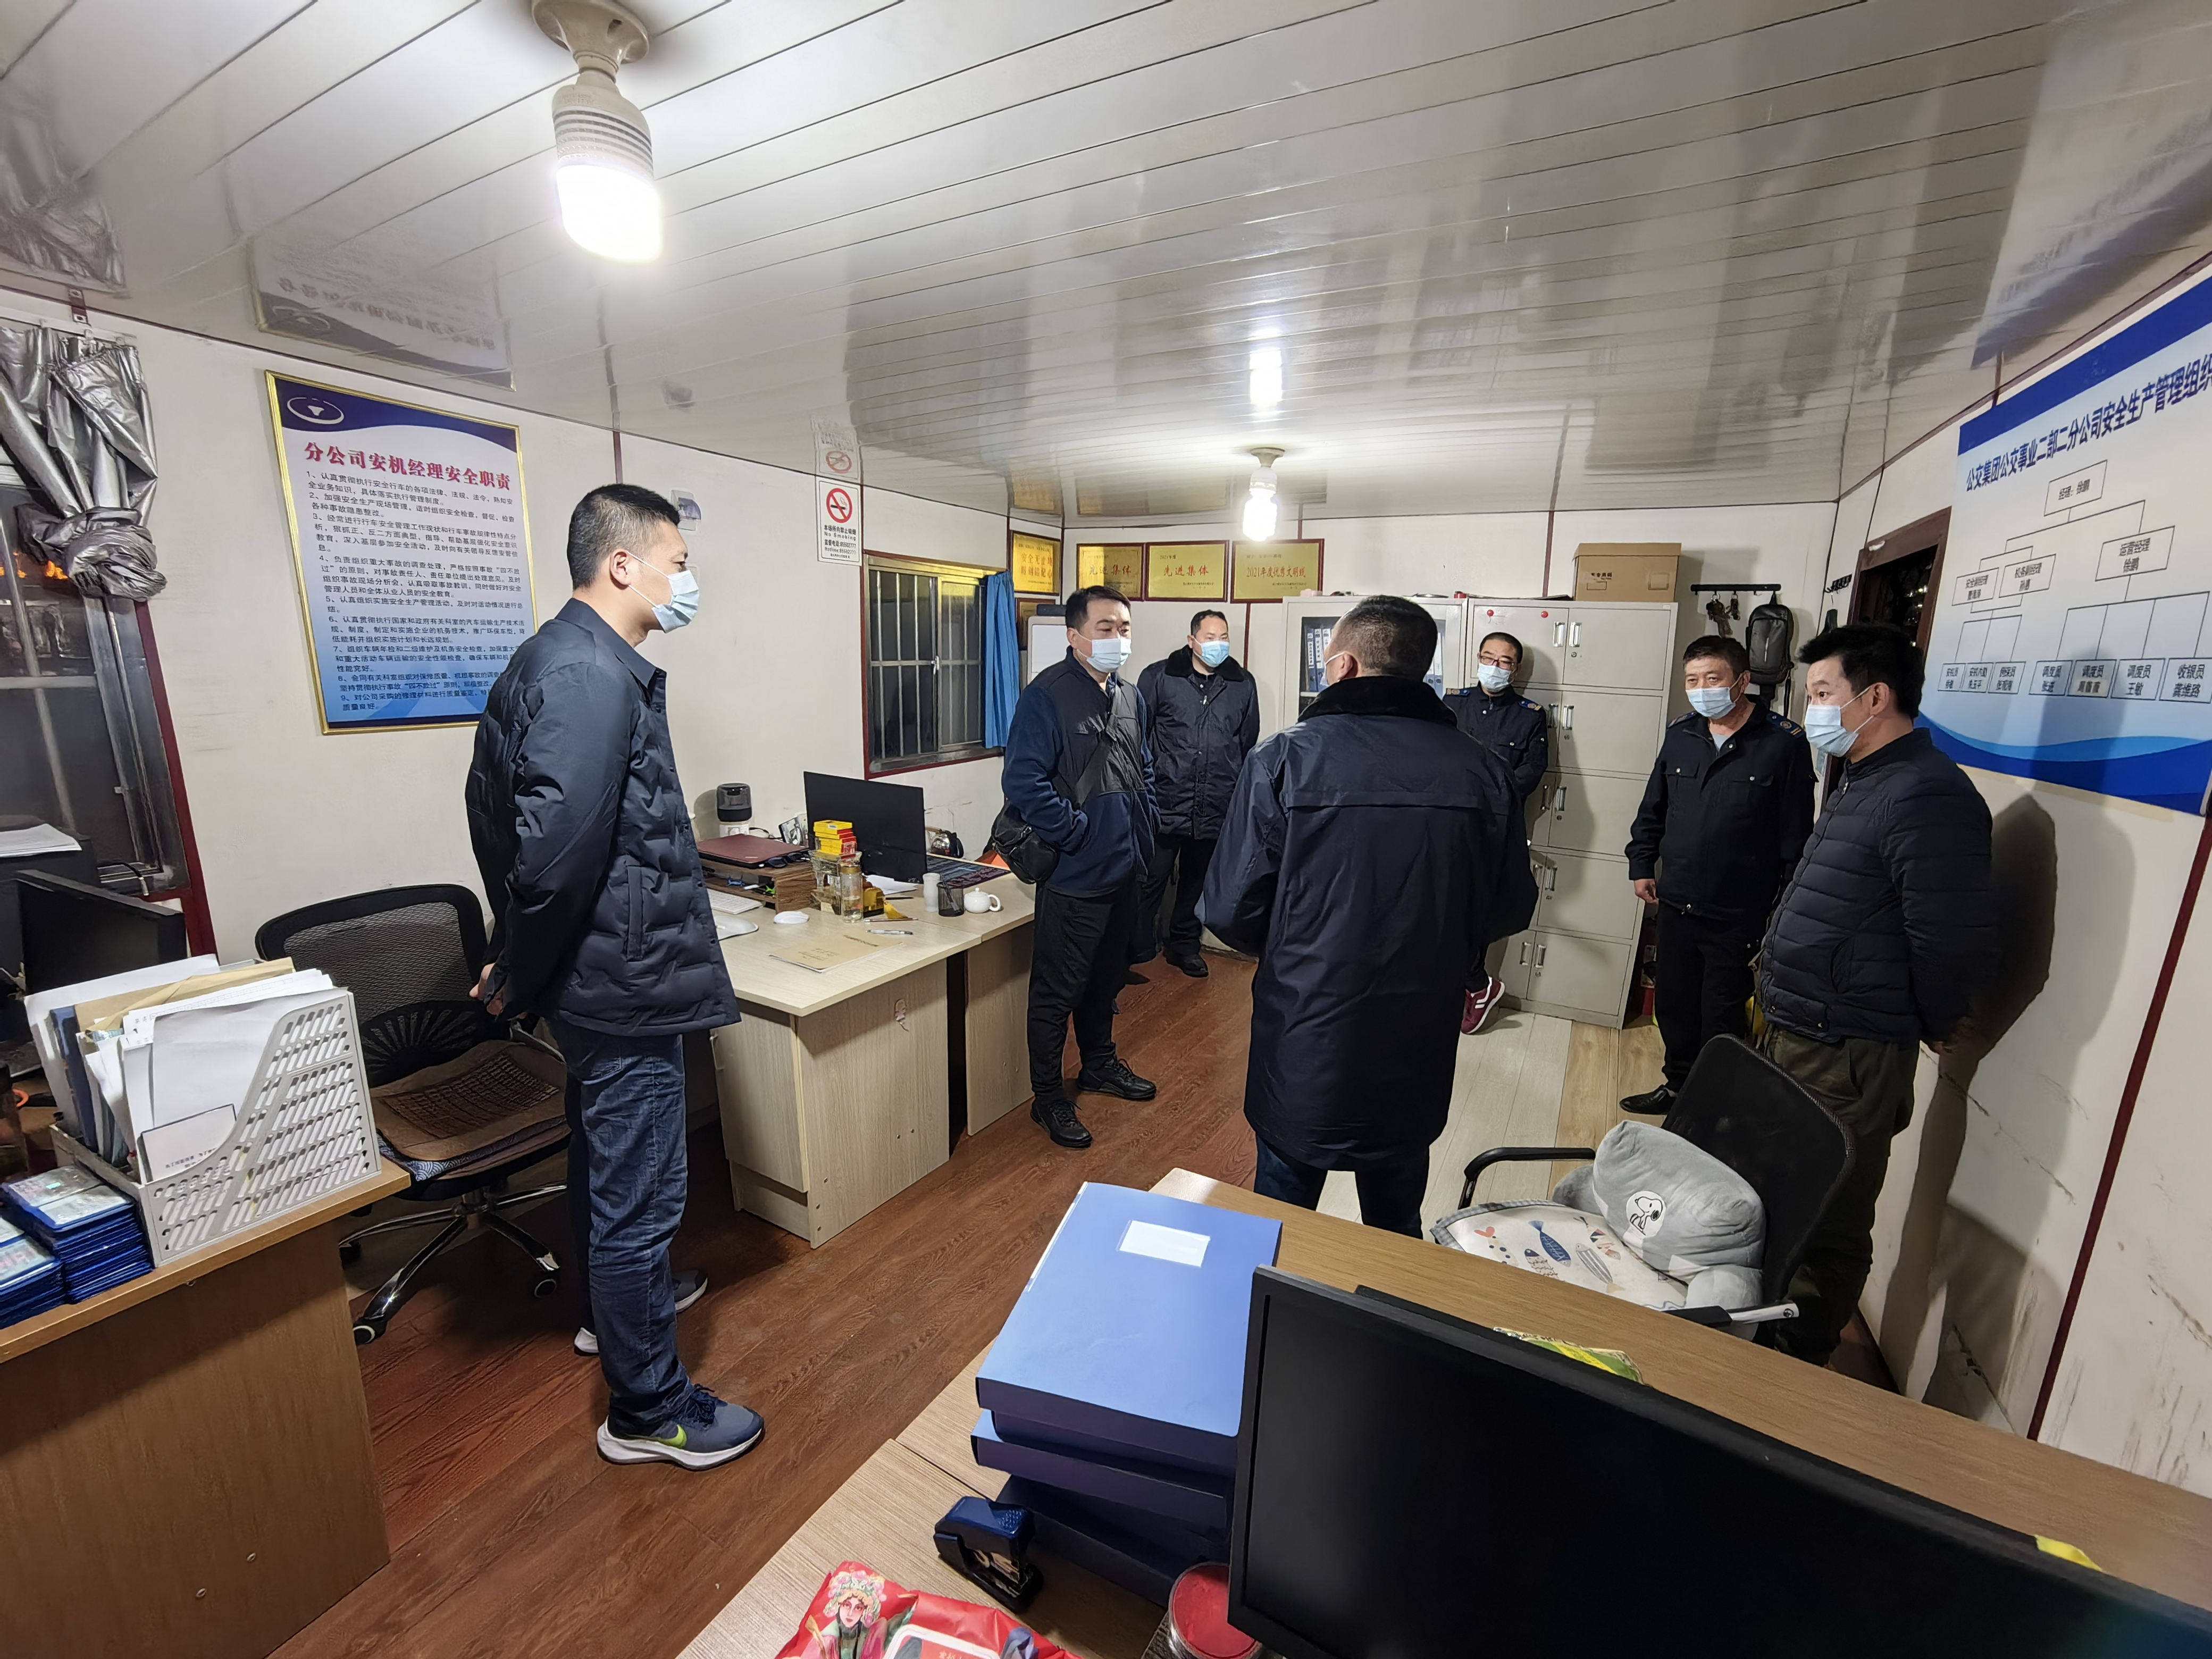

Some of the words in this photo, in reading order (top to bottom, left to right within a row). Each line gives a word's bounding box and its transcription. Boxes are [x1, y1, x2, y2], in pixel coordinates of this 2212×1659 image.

[304, 442, 510, 490] 分公司安机经理安全职责
[833, 532, 856, 541] Smoking
[1089, 564, 1131, 575] 先进集体
[1163, 565, 1209, 577] 先进集体
[2127, 665, 2151, 678] 调度员
